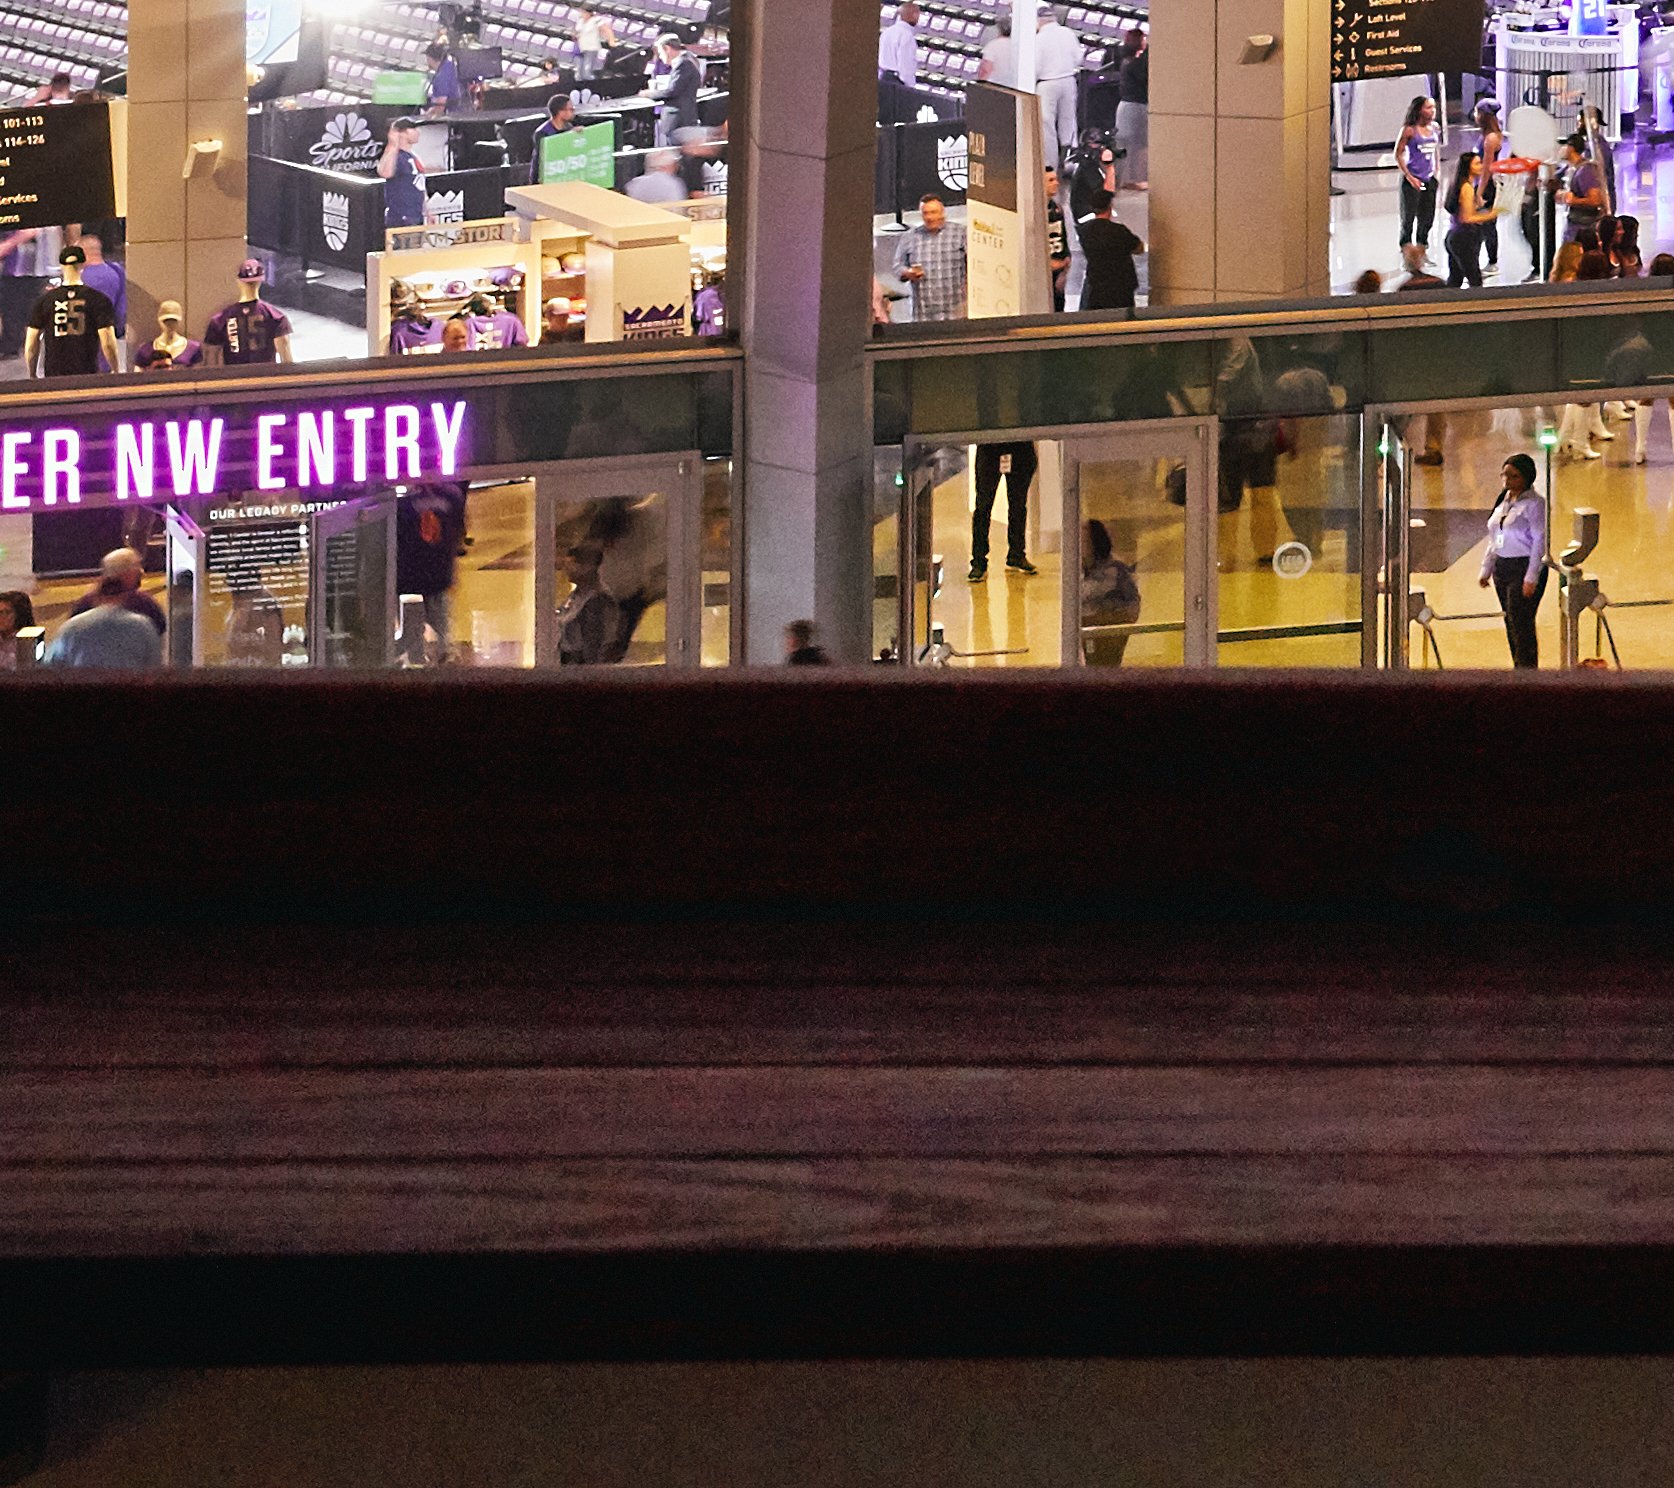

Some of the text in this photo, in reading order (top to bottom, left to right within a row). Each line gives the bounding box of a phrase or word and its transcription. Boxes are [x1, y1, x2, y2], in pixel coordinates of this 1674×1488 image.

[1385, 12, 1406, 22] Level
[1386, 28, 1400, 38] Aid
[1389, 44, 1423, 54] Services
[3, 115, 44, 129] 101-113
[54, 300, 69, 337] FOX
[116, 417, 224, 501] NW
[257, 400, 468, 490] ENTRY
[209, 510, 236, 520] OUR
